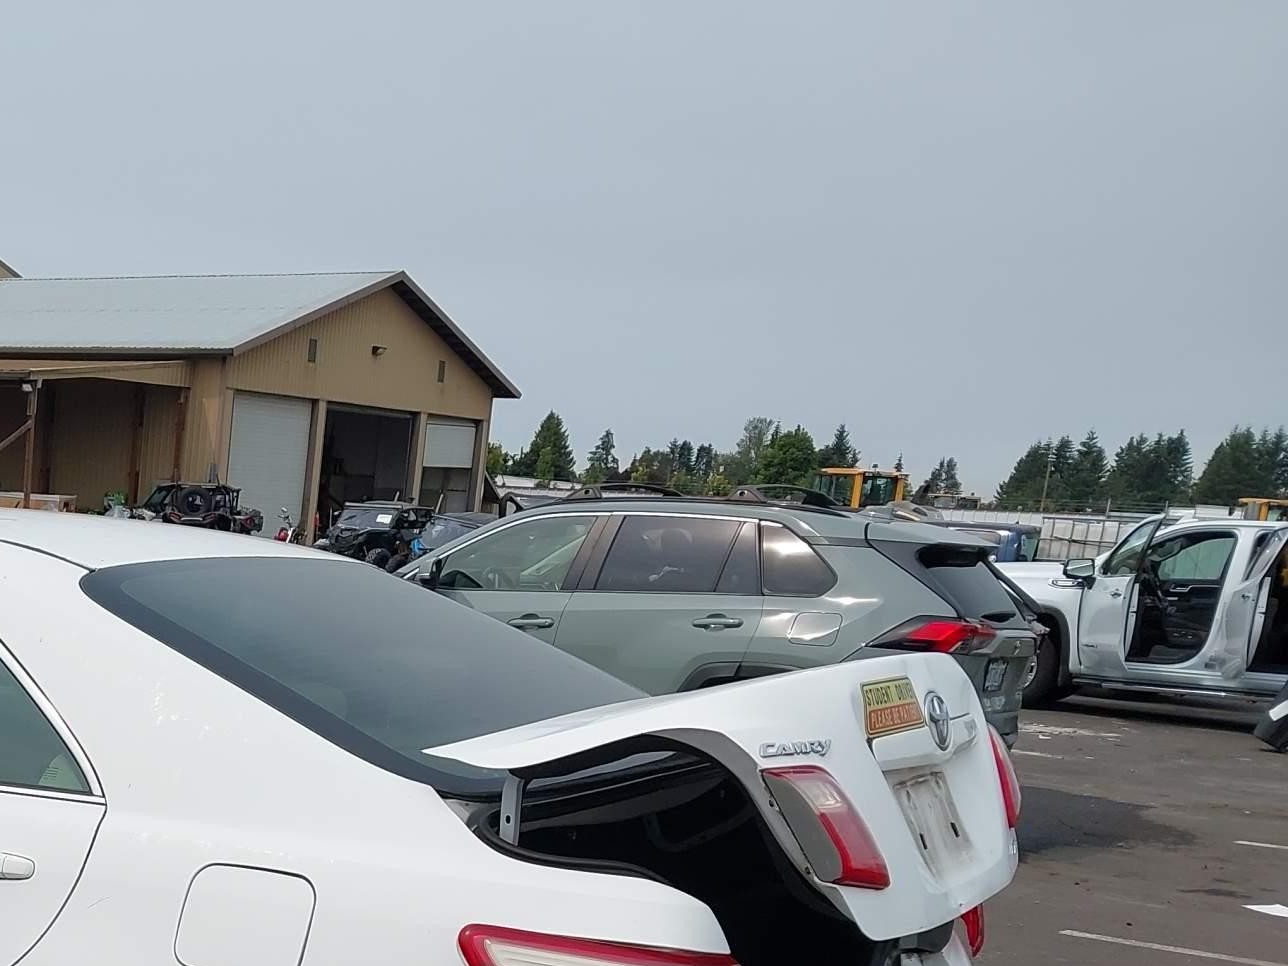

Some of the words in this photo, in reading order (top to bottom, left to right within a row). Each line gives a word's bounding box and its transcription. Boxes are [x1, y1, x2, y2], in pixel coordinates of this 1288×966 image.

[865, 685, 894, 706] STUDENT
[871, 709, 893, 729] PLEASE
[900, 703, 922, 723] PATI
[759, 739, 831, 758] CAMRY
